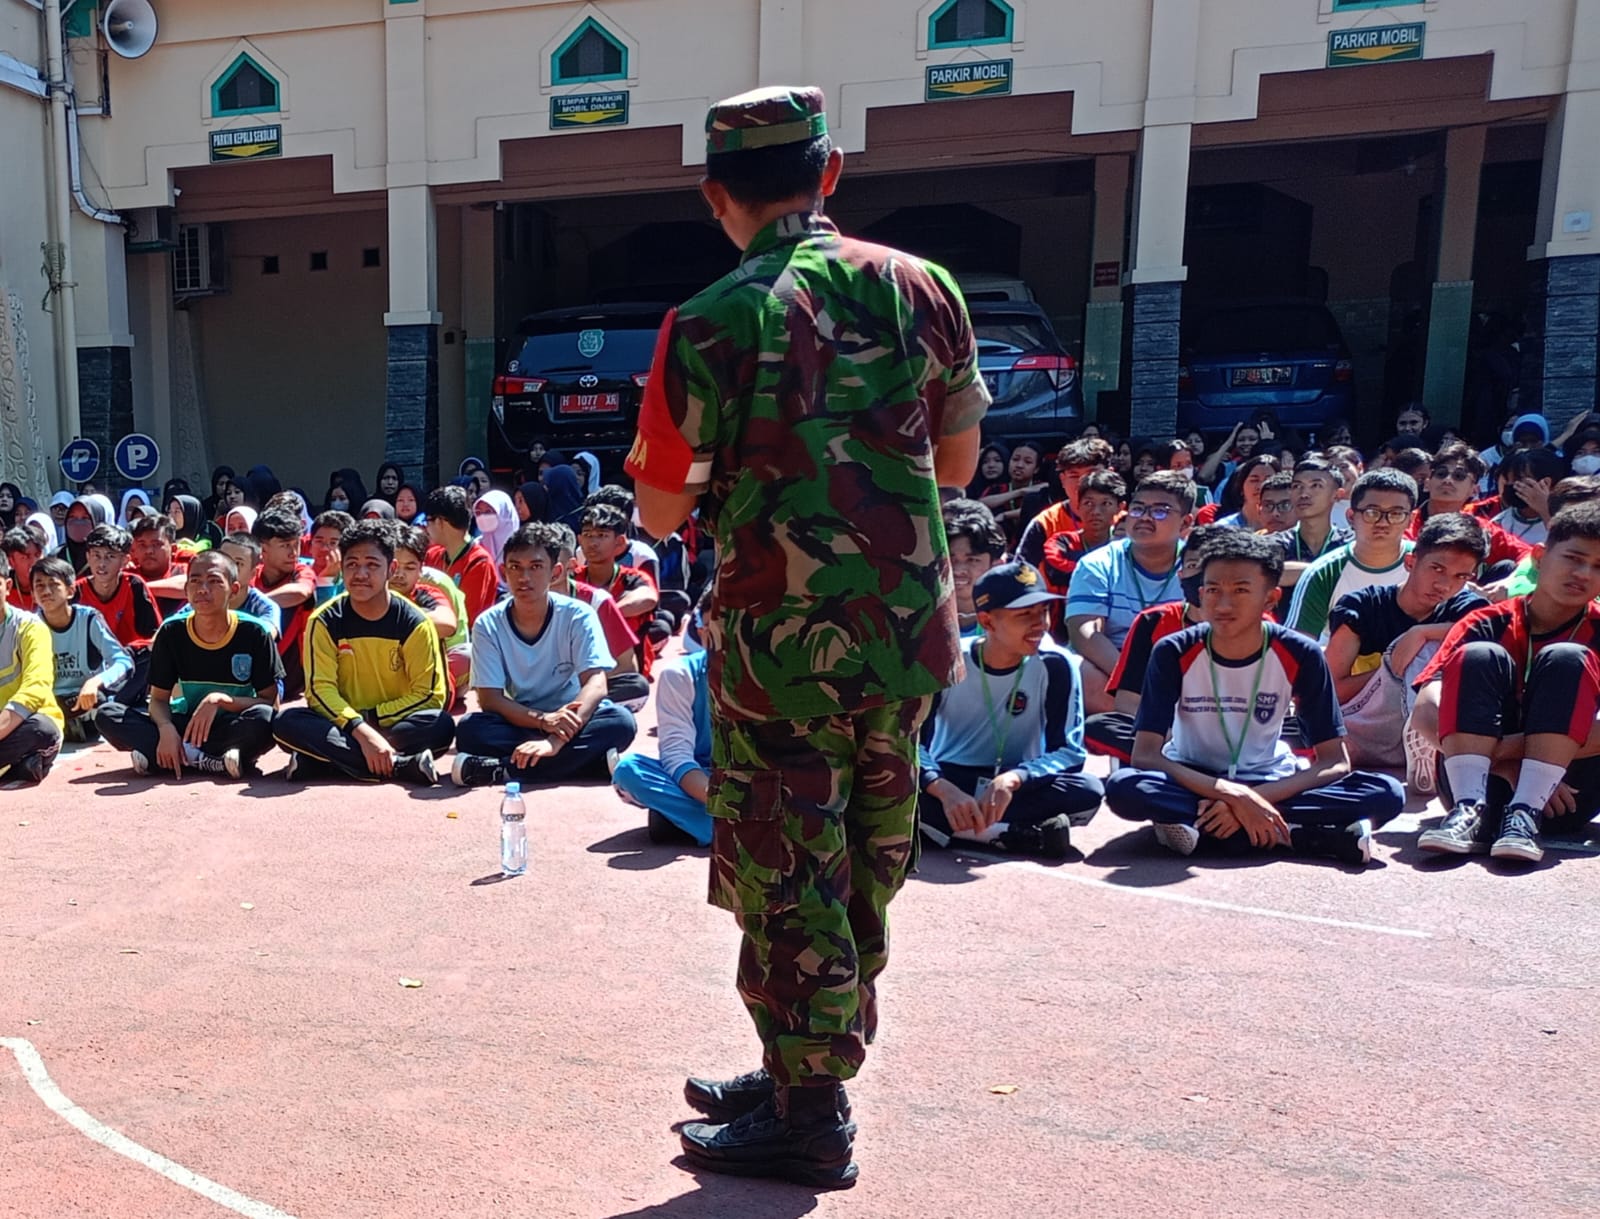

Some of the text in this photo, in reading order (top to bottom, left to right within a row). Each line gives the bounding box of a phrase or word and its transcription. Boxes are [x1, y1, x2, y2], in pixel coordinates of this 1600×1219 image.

[1333, 27, 1419, 49] PARKIR MOBIL
[930, 63, 1008, 84] PARKIR MOBIL
[557, 94, 623, 106] TEMPAT PARKIR
[562, 102, 617, 113] MOBIL DINAS
[234, 131, 253, 145] KEPALA
[253, 128, 278, 143] SEKOLAH
[562, 394, 570, 407] H
[577, 393, 598, 407] 1077
